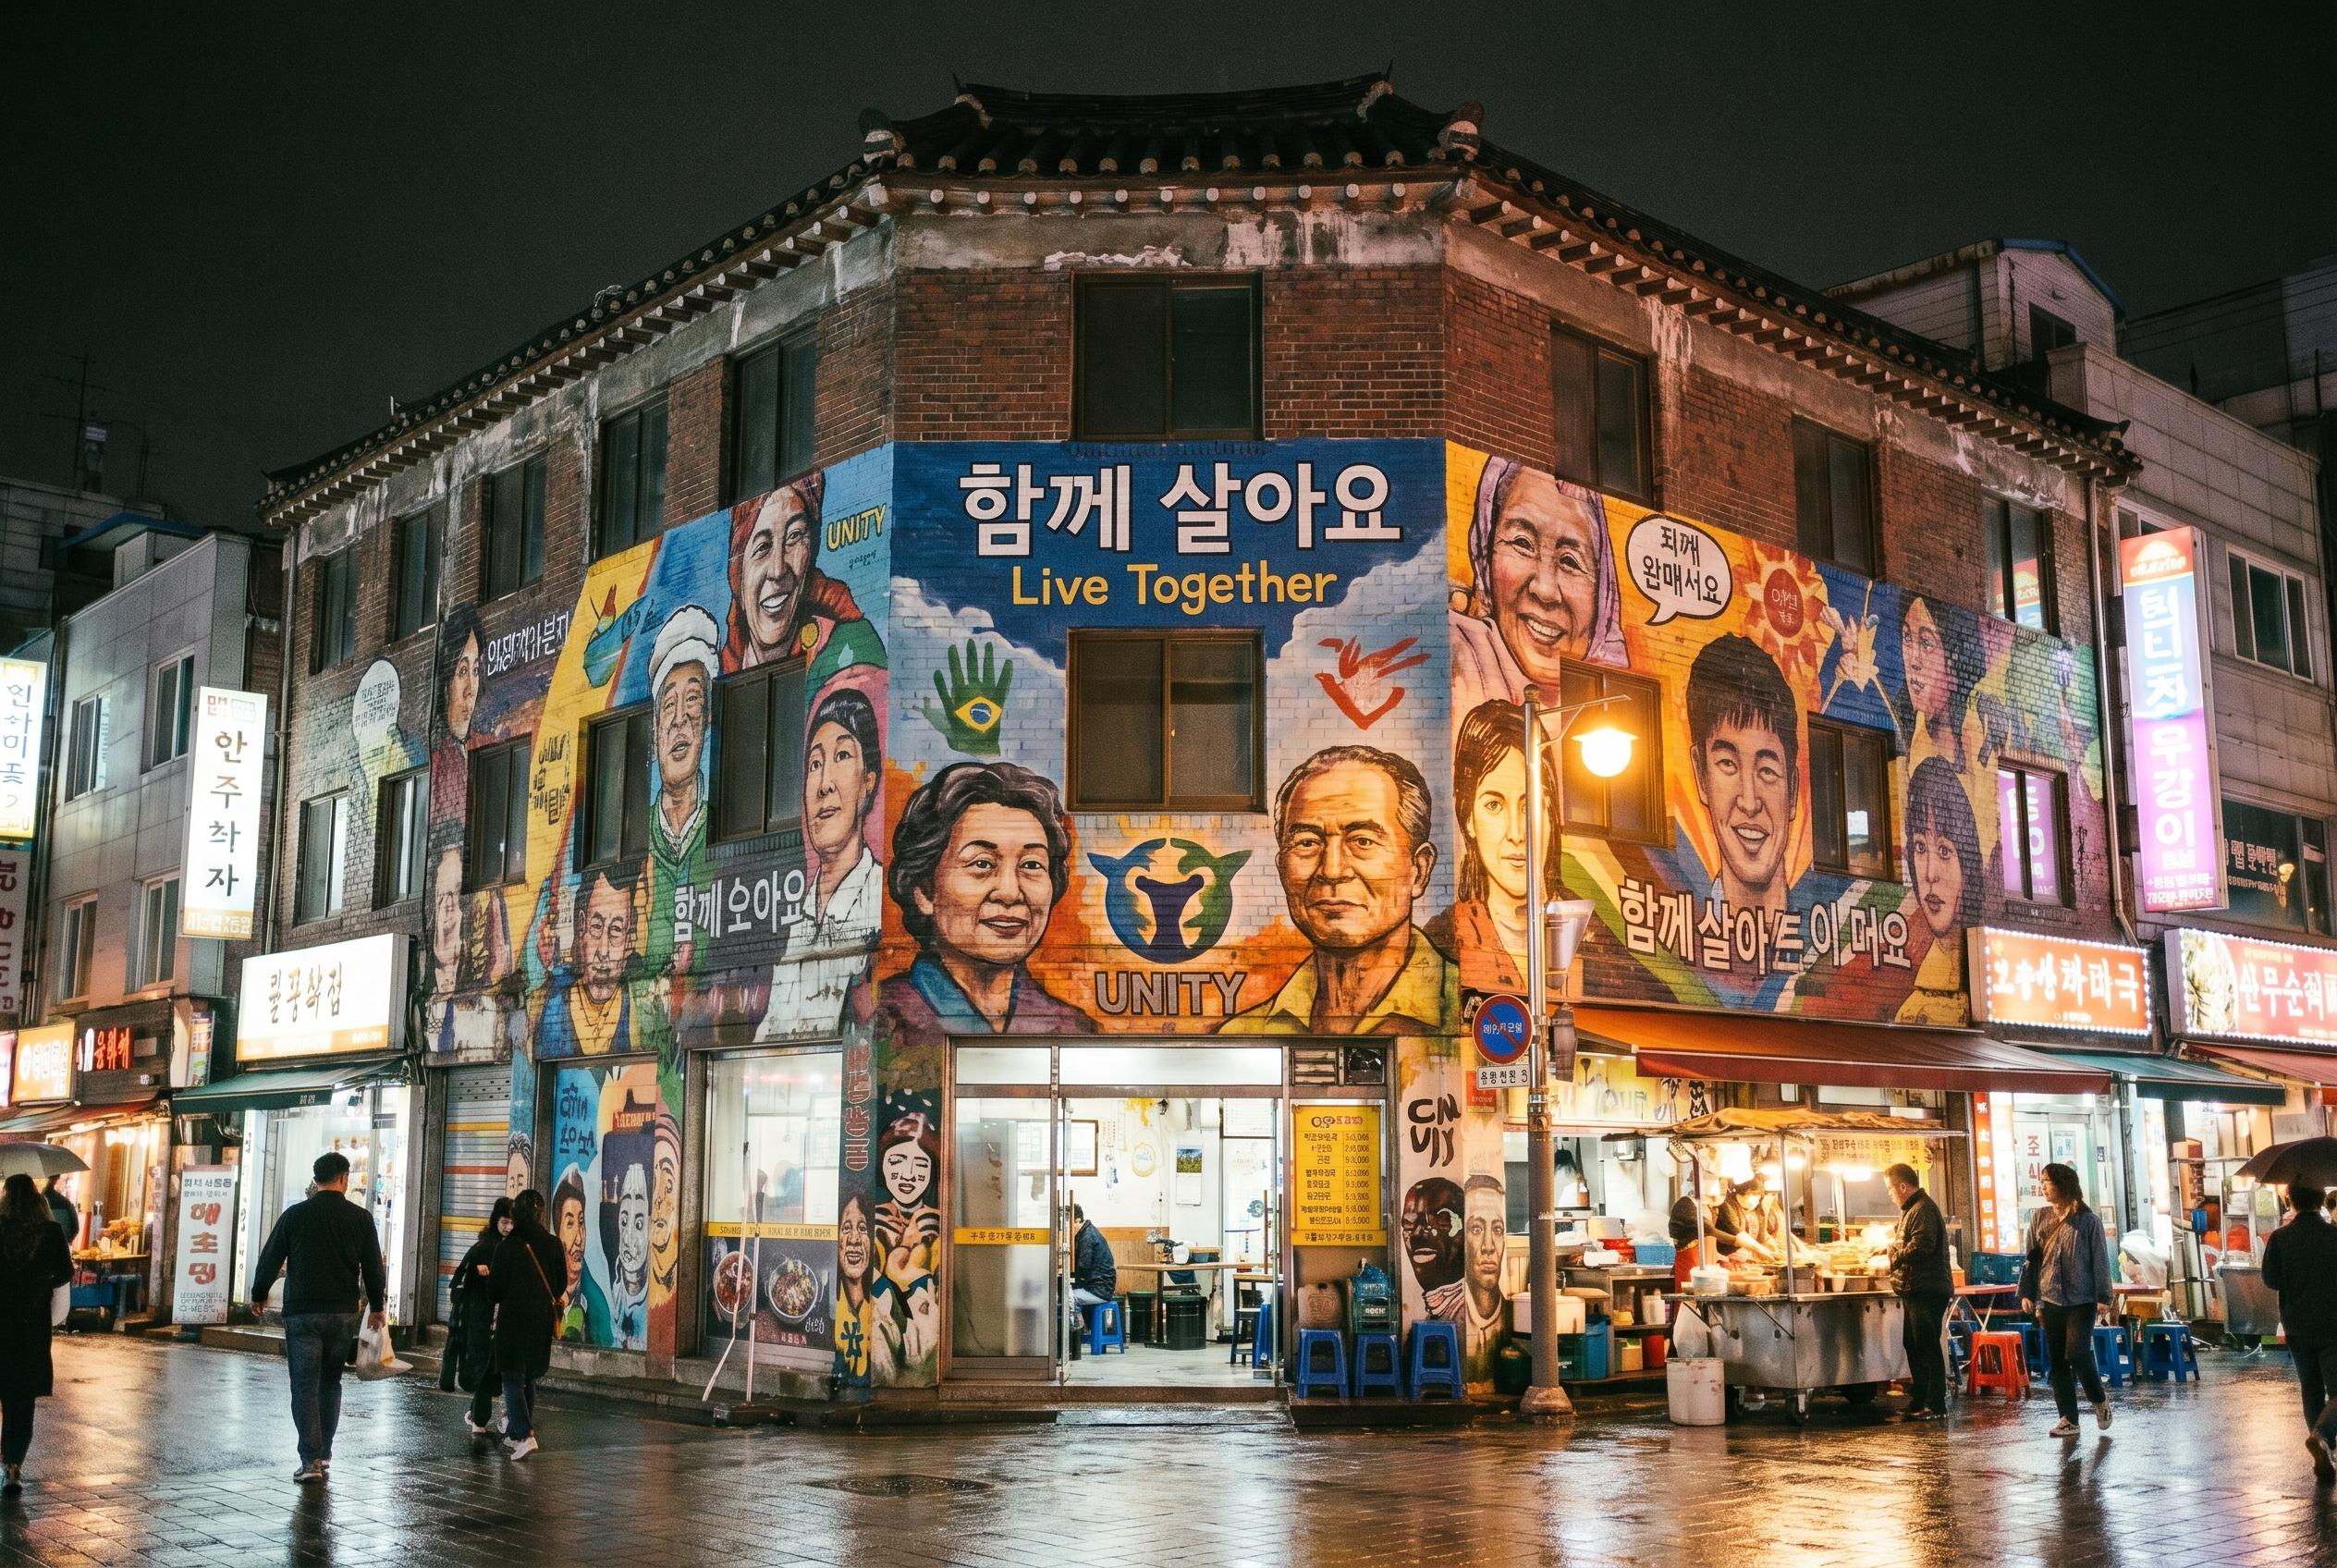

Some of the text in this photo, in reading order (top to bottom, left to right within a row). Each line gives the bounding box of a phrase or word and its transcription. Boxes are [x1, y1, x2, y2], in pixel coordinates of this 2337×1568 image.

[826, 503, 887, 552] UNITY
[959, 461, 1404, 557] 함께 살아요
[1012, 559, 1339, 615] Live Together
[674, 879, 723, 942] 함께
[1618, 876, 1695, 964] 함께
[1095, 971, 1248, 1017] UNITY
